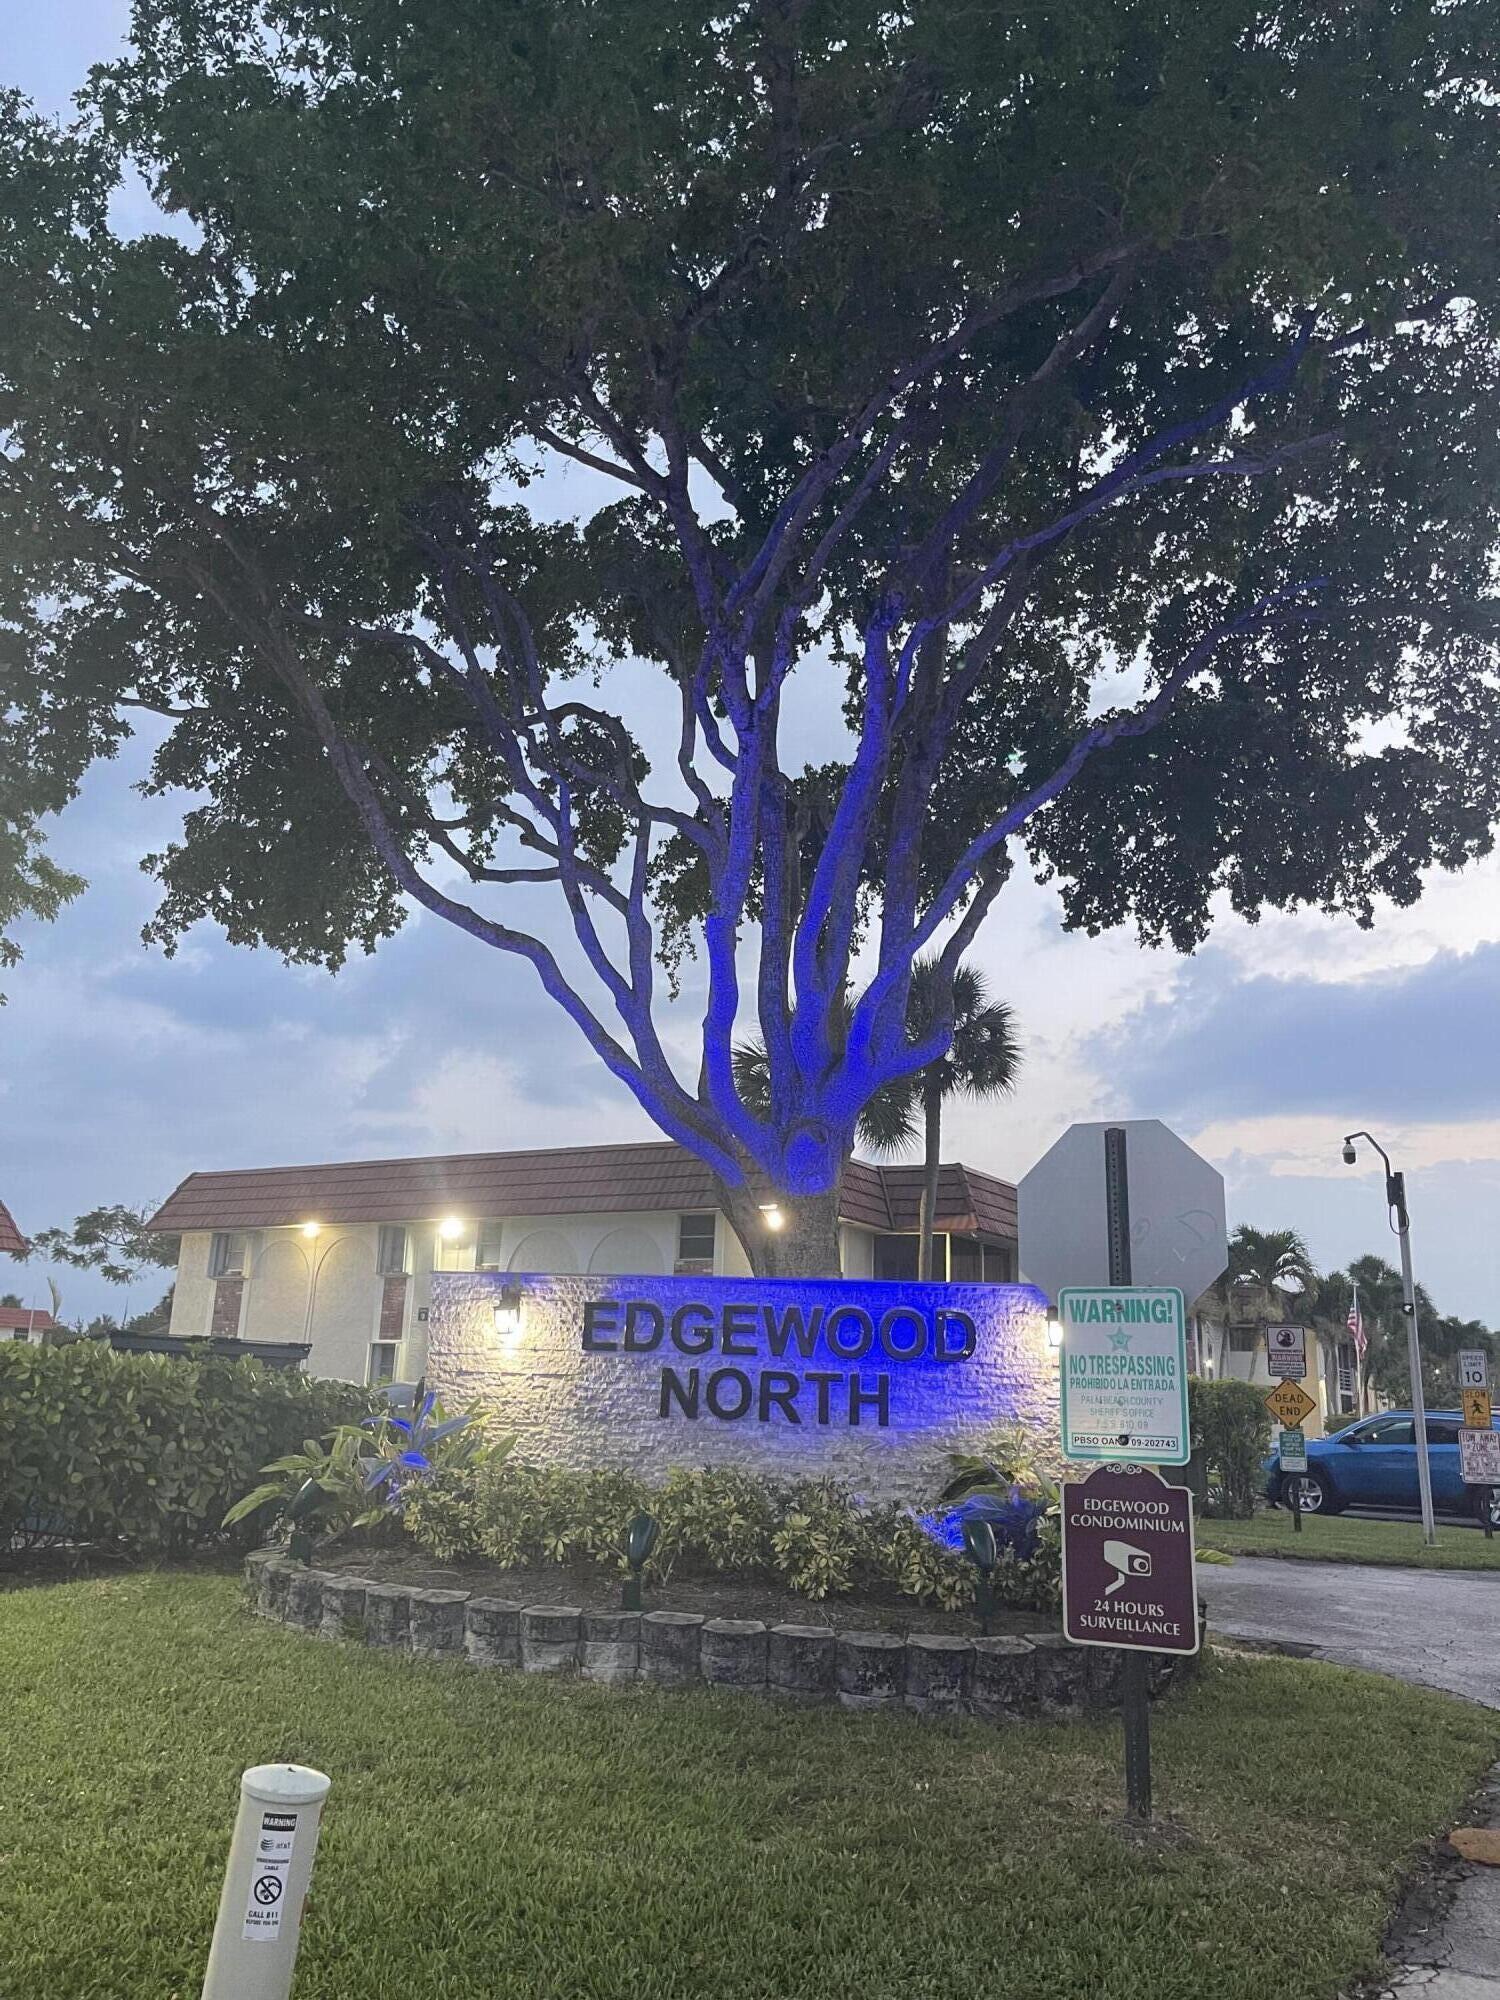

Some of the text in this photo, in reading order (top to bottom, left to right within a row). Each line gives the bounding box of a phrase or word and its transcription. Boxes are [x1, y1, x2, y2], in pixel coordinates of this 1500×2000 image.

[1069, 1298, 1173, 1324] WARNING!
[581, 1300, 977, 1363] EDGEWOOD
[1069, 1354, 1175, 1377] NO TRESPASSING
[1070, 1378, 1175, 1391] PROHIBIDO LA ENTRADA
[1466, 1371, 1483, 1383] 10
[658, 1367, 890, 1427] NORTH
[1275, 1393, 1304, 1404] DEAD
[1280, 1406, 1301, 1416] END
[1074, 1436, 1100, 1445] PBSO
[1131, 1438, 1177, 1448] 09-202743
[1083, 1498, 1170, 1515] EDGEWOOD
[1070, 1514, 1185, 1533] CONDOMINIUM
[1094, 1599, 1165, 1617] 24 HOURS
[1080, 1614, 1181, 1636] SURVEILLANCE
[263, 1816, 296, 1827] WARNING
[248, 1910, 279, 1919] CALL 811
